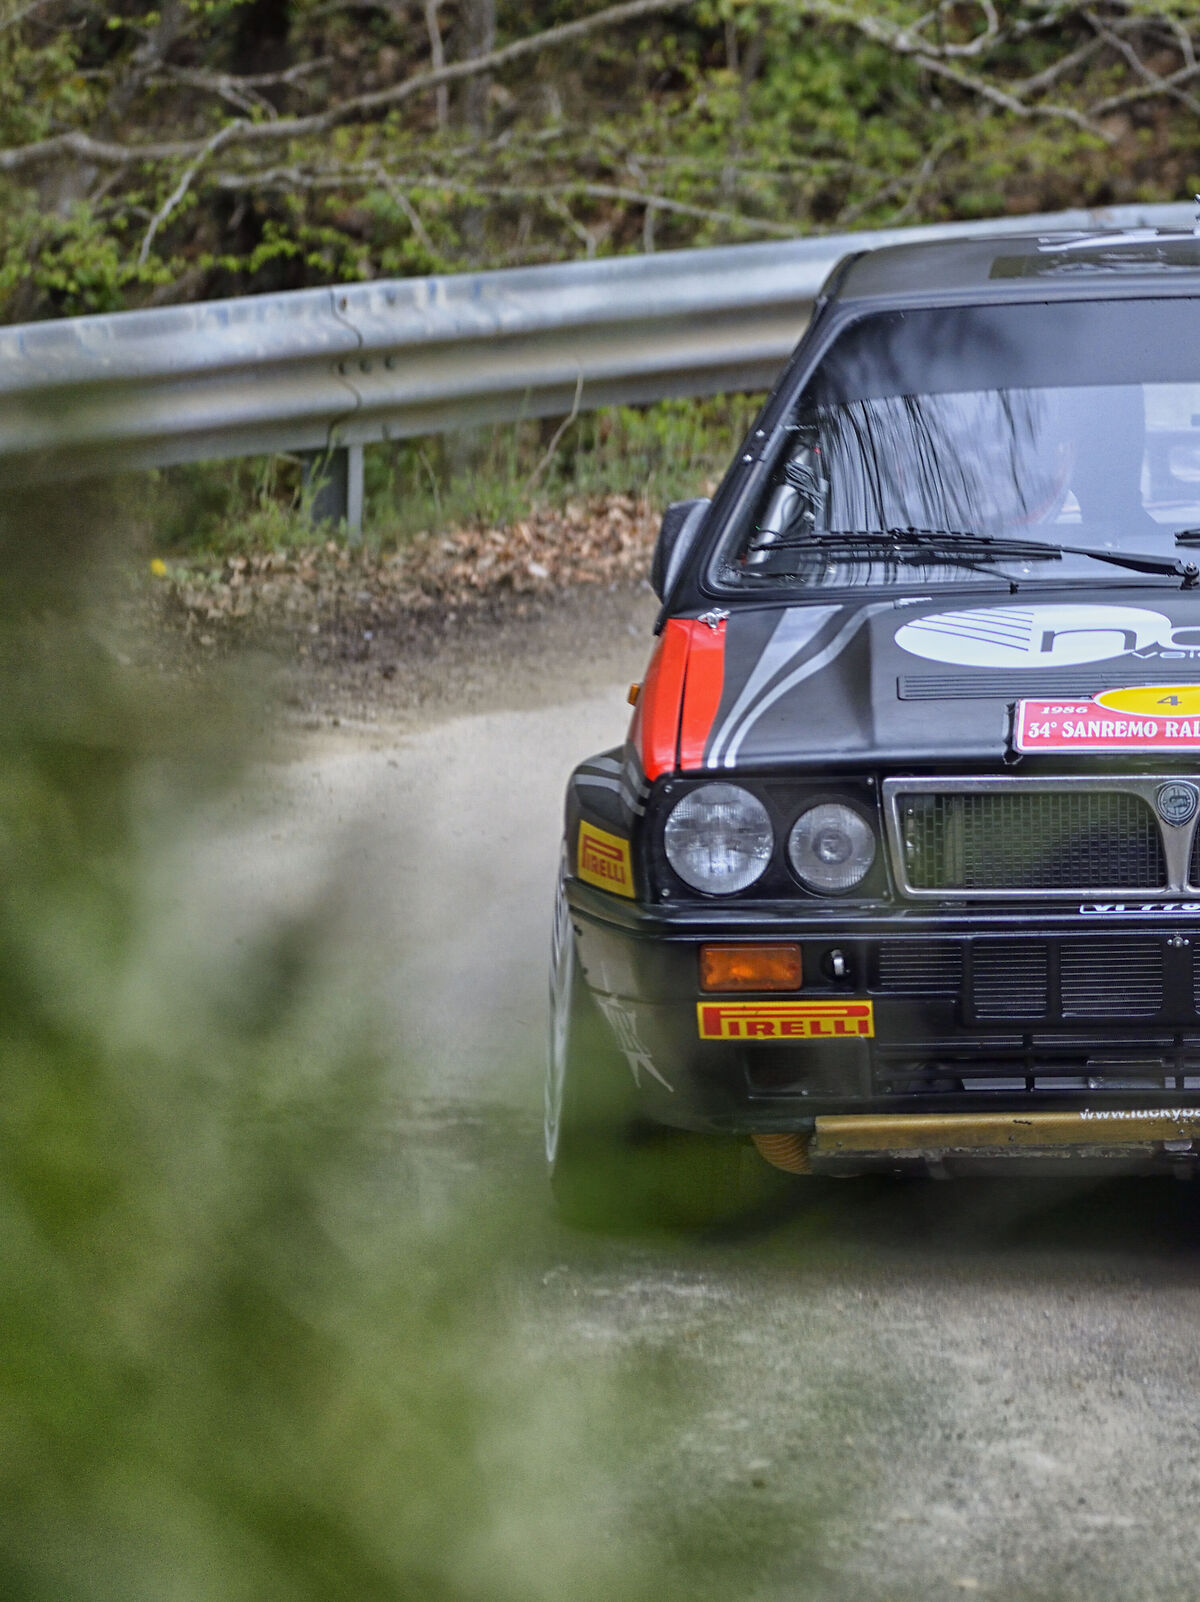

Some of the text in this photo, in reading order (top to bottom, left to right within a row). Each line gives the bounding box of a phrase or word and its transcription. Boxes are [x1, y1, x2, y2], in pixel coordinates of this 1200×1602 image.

[1156, 695, 1182, 706] 4
[1040, 705, 1088, 715] 1986
[1061, 720, 1158, 738] SANREMO
[581, 833, 627, 885] PIRELLI
[702, 1005, 870, 1036] PIRELLI
